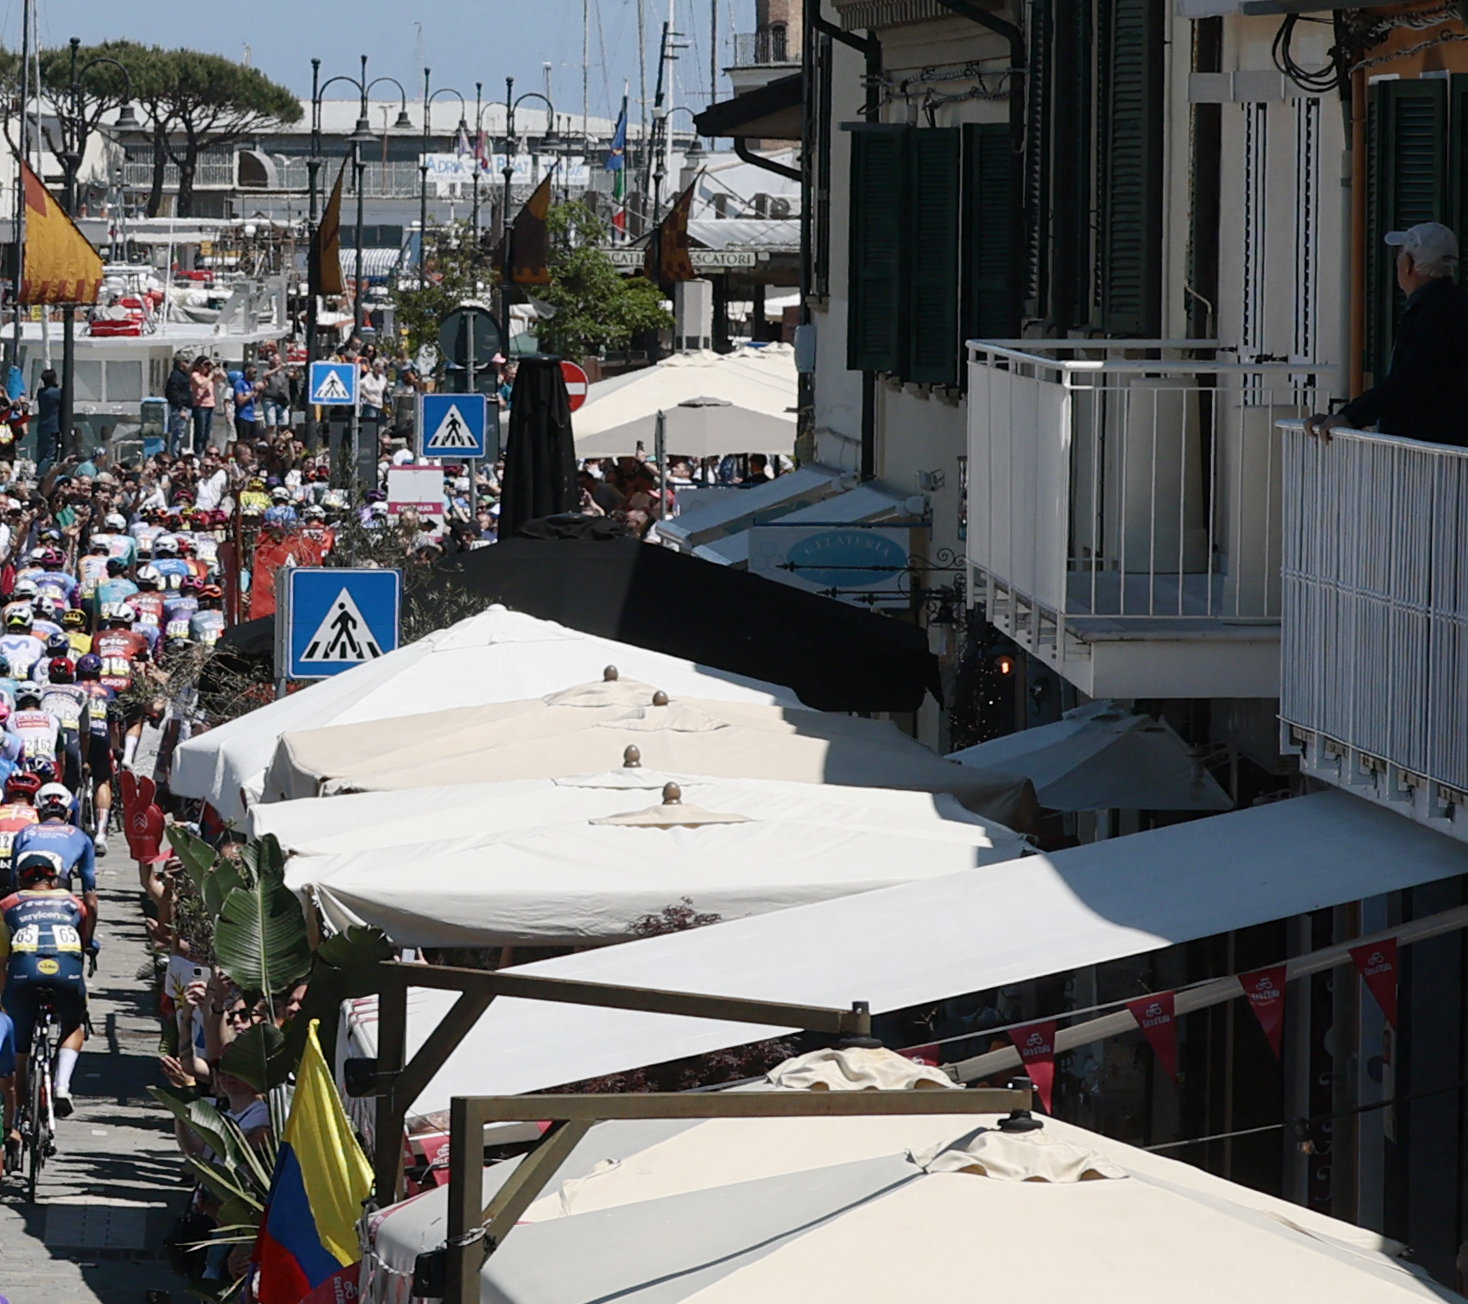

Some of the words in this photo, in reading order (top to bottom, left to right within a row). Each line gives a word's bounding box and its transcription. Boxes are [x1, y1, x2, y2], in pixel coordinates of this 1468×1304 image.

[426, 155, 466, 174] ADRIA
[16, 927, 34, 944] 65
[59, 927, 77, 943] 65
